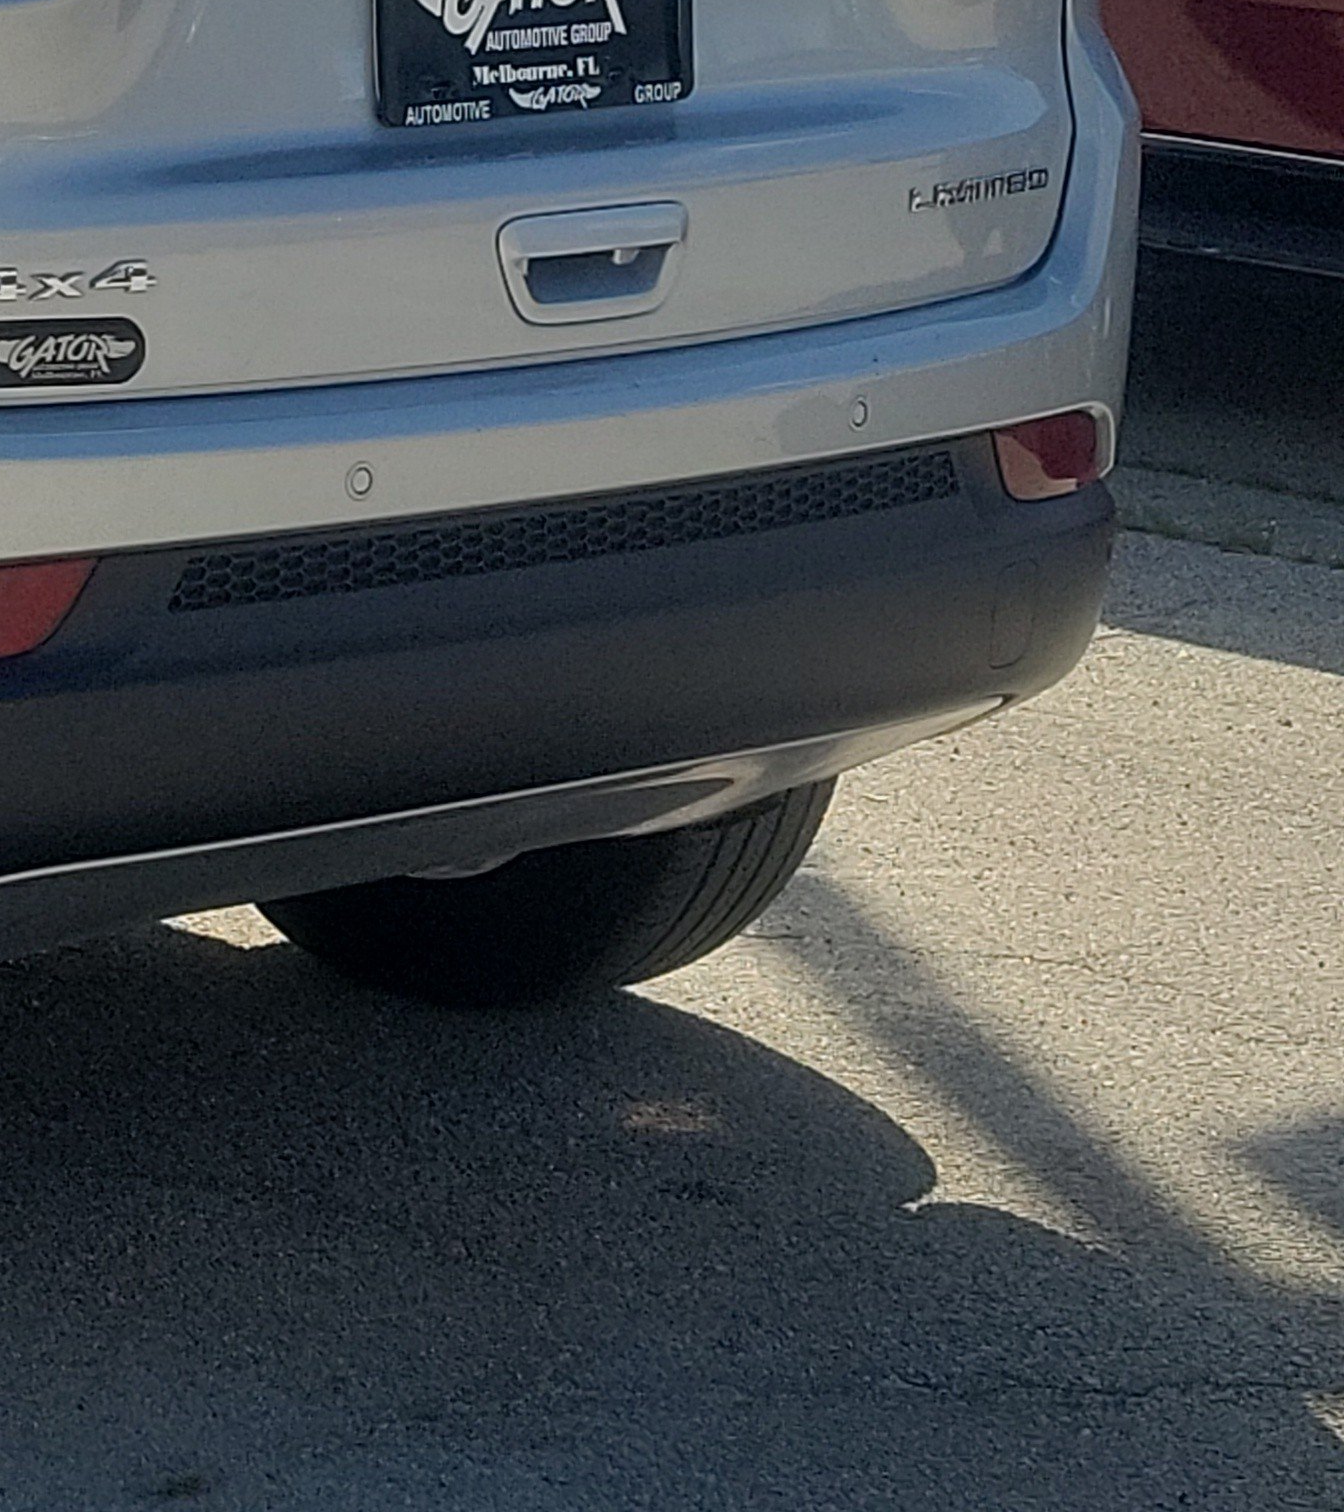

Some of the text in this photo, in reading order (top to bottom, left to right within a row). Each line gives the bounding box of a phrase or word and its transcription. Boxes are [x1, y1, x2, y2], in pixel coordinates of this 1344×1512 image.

[485, 21, 612, 52] AUTOMOTIVE GROUP
[576, 56, 601, 76] FL
[405, 82, 682, 127] AUTOMOTIVE GATOR GROUP
[8, 333, 111, 378] GATOR
